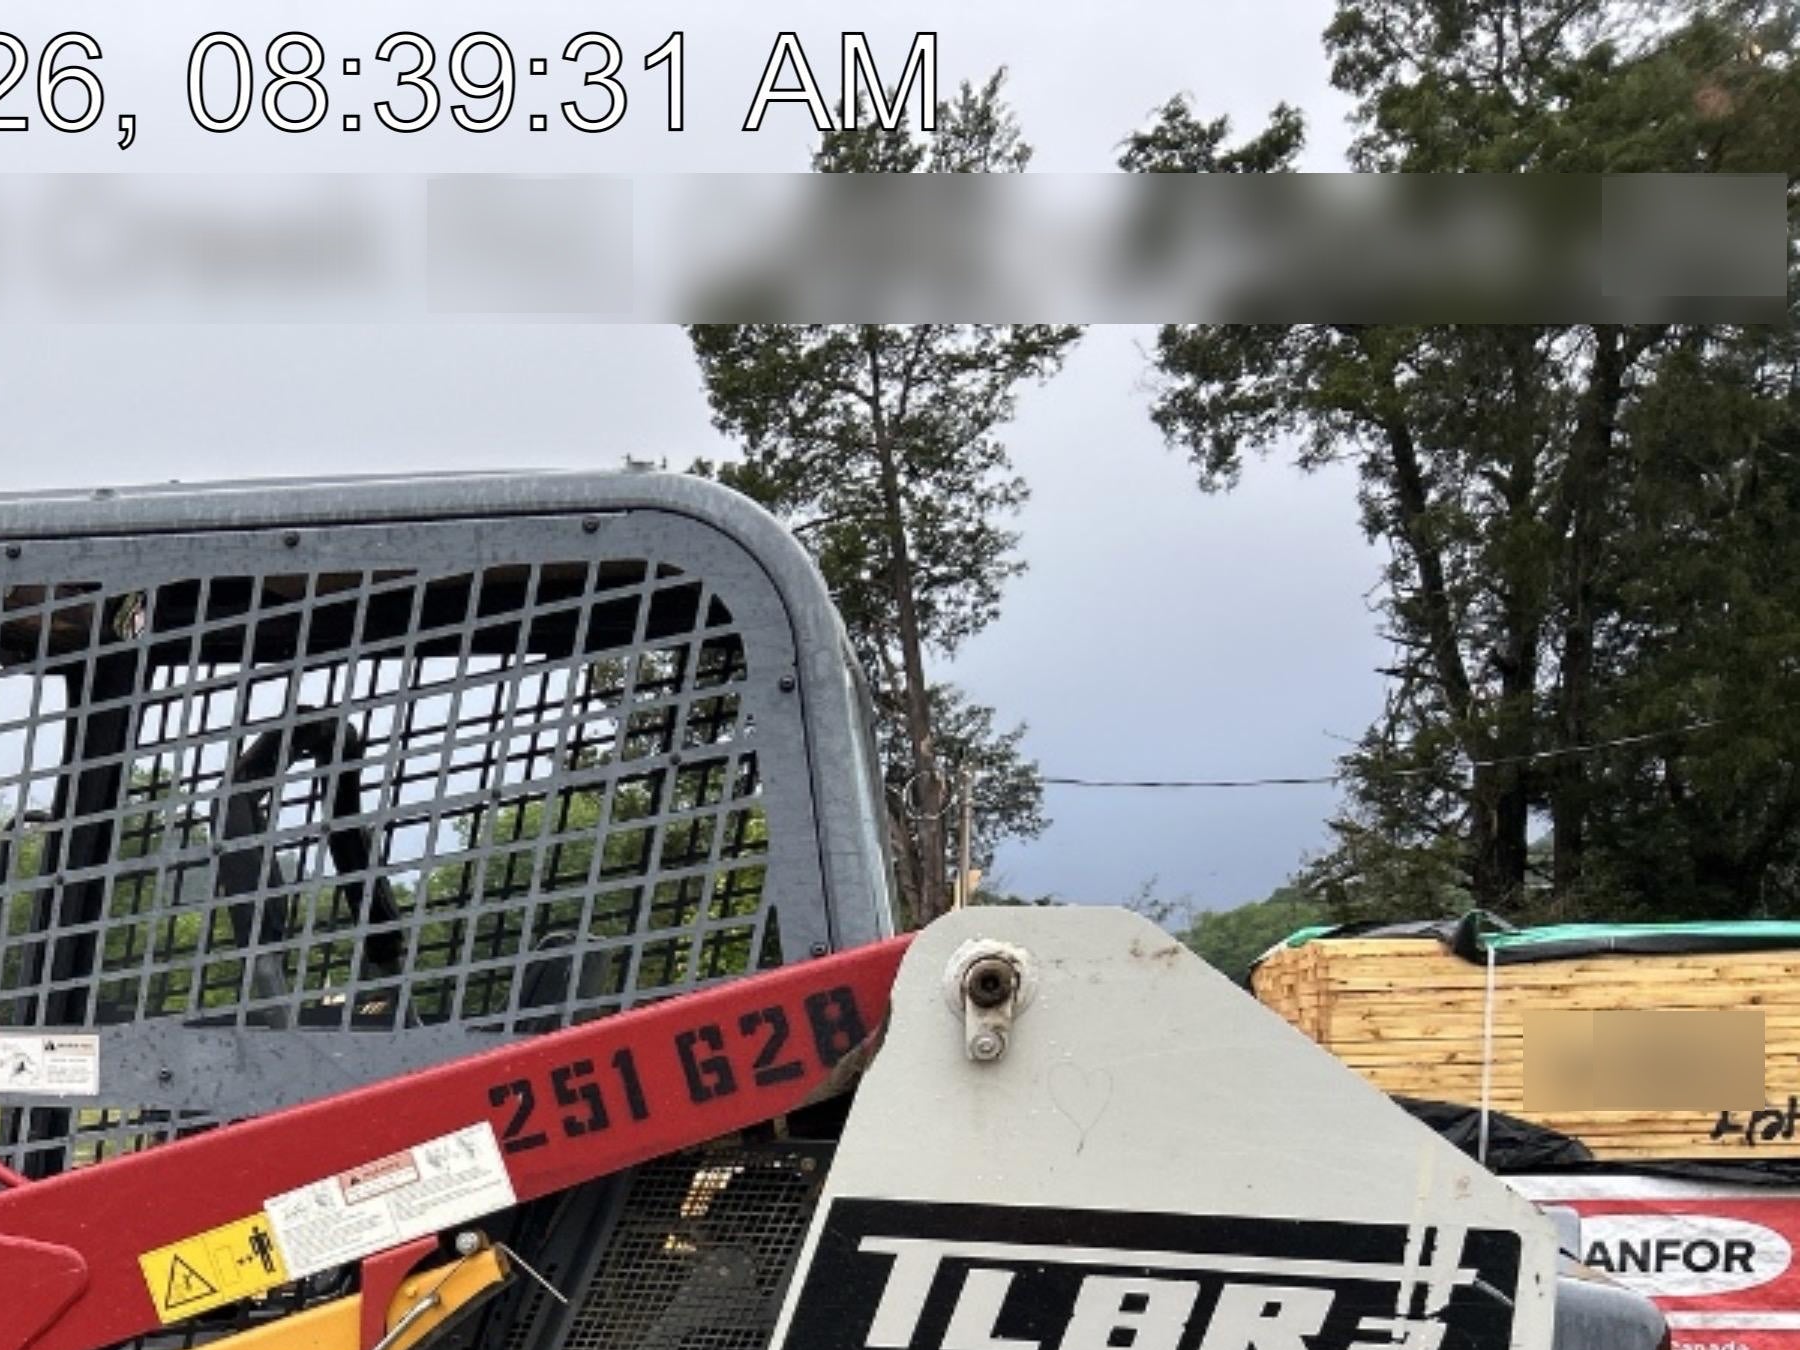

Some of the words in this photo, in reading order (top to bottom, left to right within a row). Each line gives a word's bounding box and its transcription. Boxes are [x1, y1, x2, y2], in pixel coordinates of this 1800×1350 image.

[488, 1047, 649, 1154] 251
[675, 986, 867, 1103] 628
[1583, 1239, 1757, 1274] ANFOR
